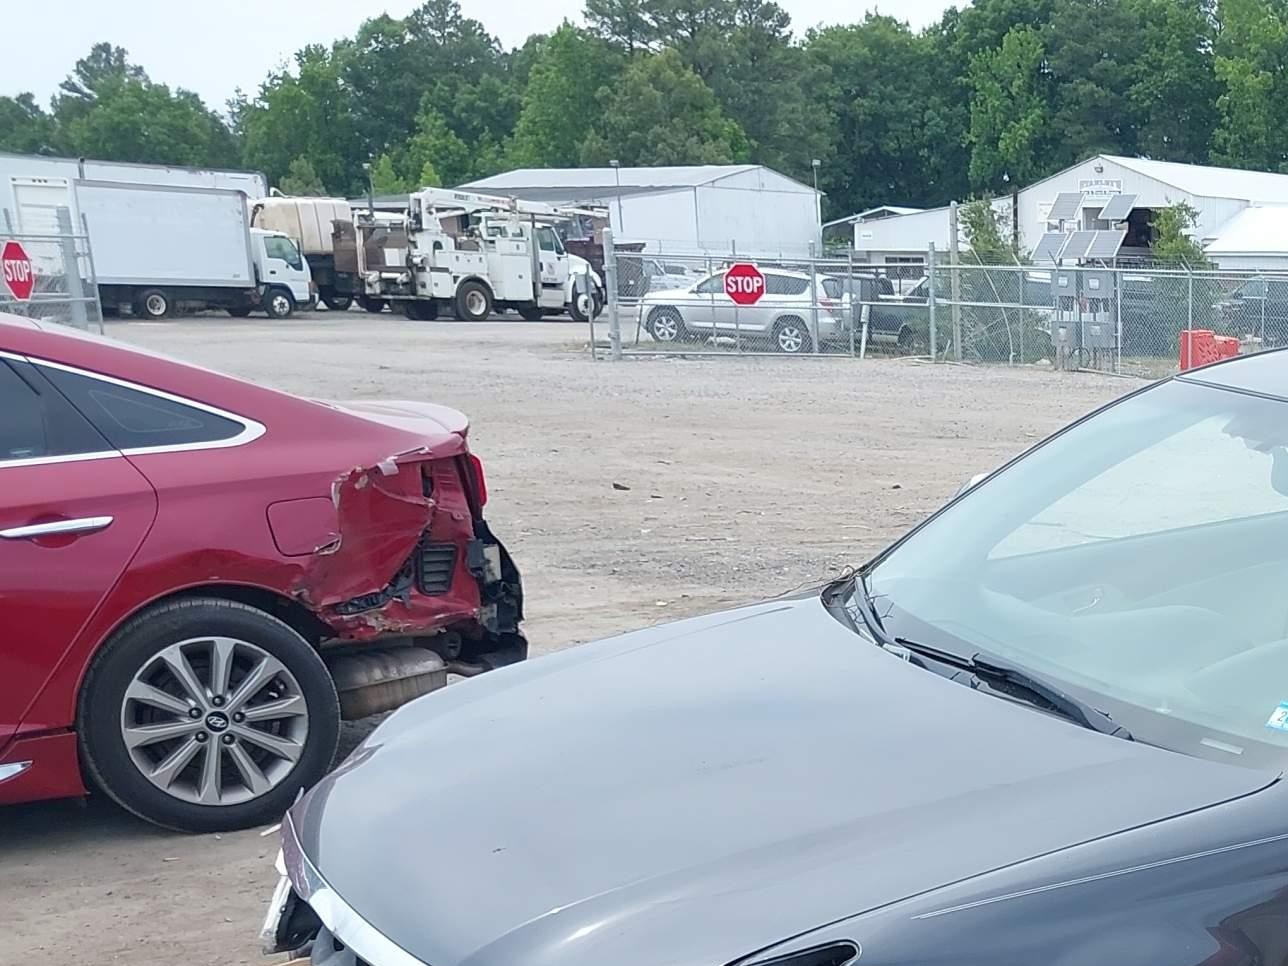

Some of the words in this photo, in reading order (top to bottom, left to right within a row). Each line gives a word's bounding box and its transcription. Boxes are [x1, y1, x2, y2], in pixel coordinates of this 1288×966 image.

[4, 259, 30, 282] STOP
[727, 276, 763, 293] STOP
[1276, 710, 1288, 722] 2
